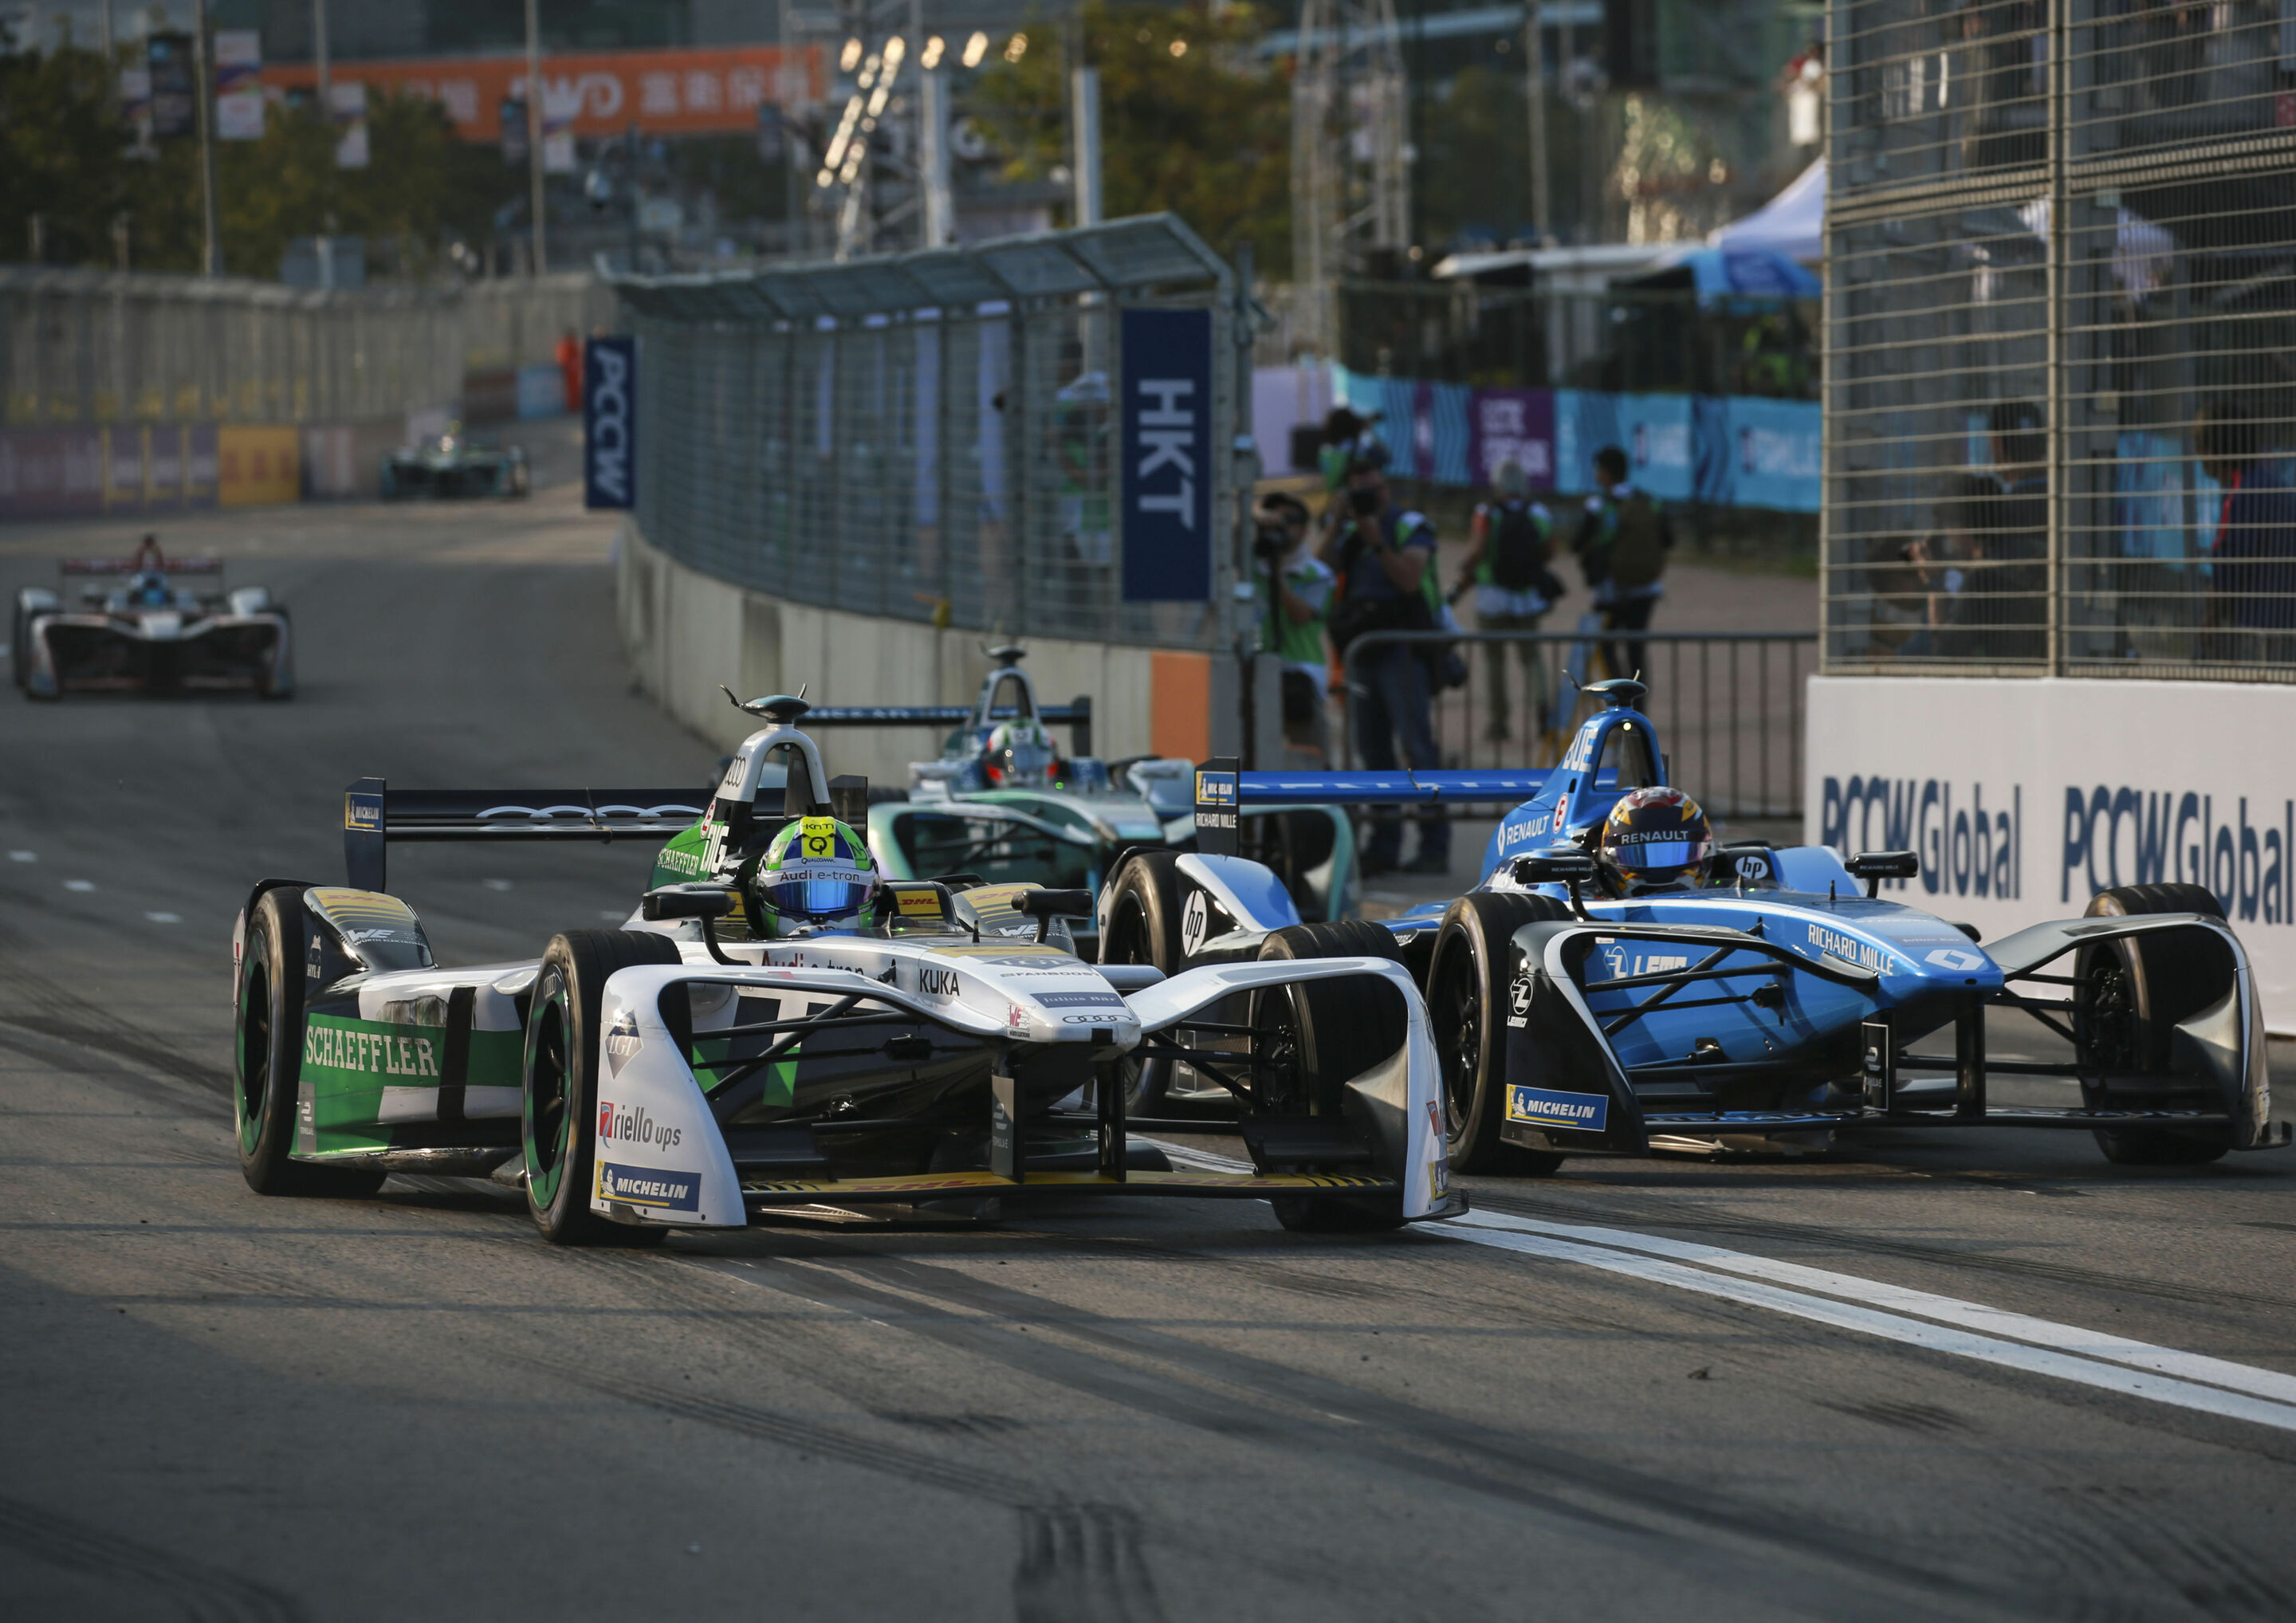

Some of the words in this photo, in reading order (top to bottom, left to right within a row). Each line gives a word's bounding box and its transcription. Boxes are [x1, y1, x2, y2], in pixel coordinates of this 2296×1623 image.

[592, 346, 629, 505] PCCW
[1138, 378, 1196, 532] HKT
[356, 806, 379, 819] MICHELIN
[1196, 813, 1220, 829] RICHARD
[1221, 815, 1237, 829] MILLE
[1507, 815, 1551, 845] RENAULT
[1621, 831, 1689, 845] RENAULT
[657, 847, 700, 876] SCHAEFFLER
[1742, 858, 1763, 878] hp
[780, 870, 812, 882] Audi
[817, 870, 860, 882] e-tron
[898, 898, 938, 906] DHL
[975, 890, 1022, 900] DH
[346, 929, 396, 941] WE
[1185, 890, 1204, 957] hp
[1808, 923, 1857, 961] RICHARD
[1860, 944, 1895, 977] MILLE
[919, 968, 960, 996] KUKA
[1507, 1015, 1528, 1028] LEMO
[305, 1024, 438, 1077] SCHAEFFLER
[608, 1032, 639, 1057] LGT
[1526, 1098, 1596, 1119] MICHELIN
[615, 1106, 654, 1144] riello
[655, 1123, 682, 1152] ups
[616, 1177, 689, 1200] MICHELIN
